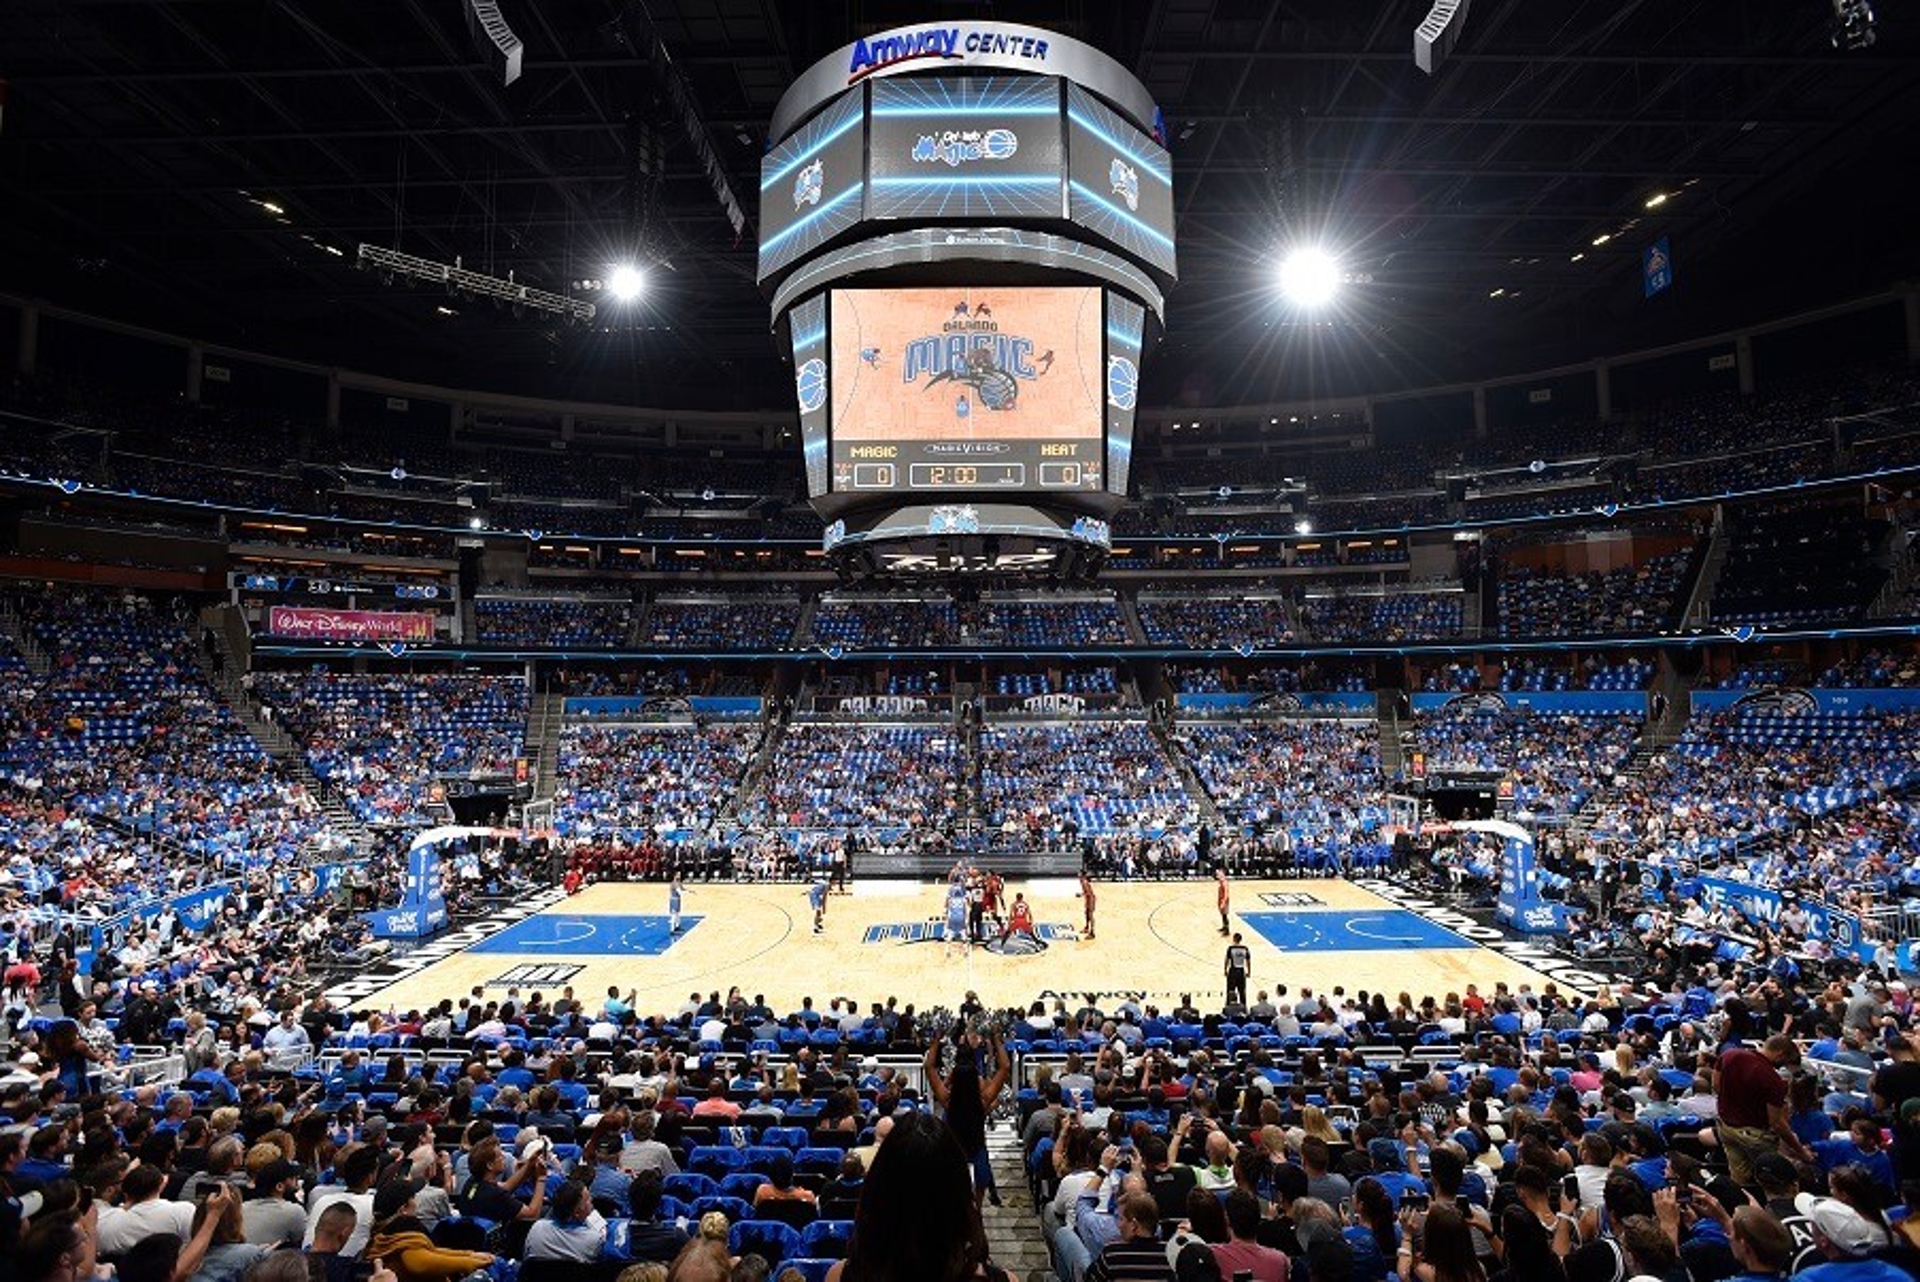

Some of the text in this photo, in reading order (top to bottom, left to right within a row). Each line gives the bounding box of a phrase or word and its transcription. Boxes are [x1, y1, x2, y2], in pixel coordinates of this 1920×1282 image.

[850, 29, 1050, 73] Amway CENTER
[942, 320, 999, 332] ORLANDO
[902, 332, 1038, 384] MAGIC
[850, 446, 898, 458] MAGIC
[1041, 443, 1078, 456] HEAT
[877, 467, 889, 484] 0
[930, 467, 977, 483] 12:00
[1062, 467, 1075, 484] 0
[278, 612, 404, 635] Walt Disney World
